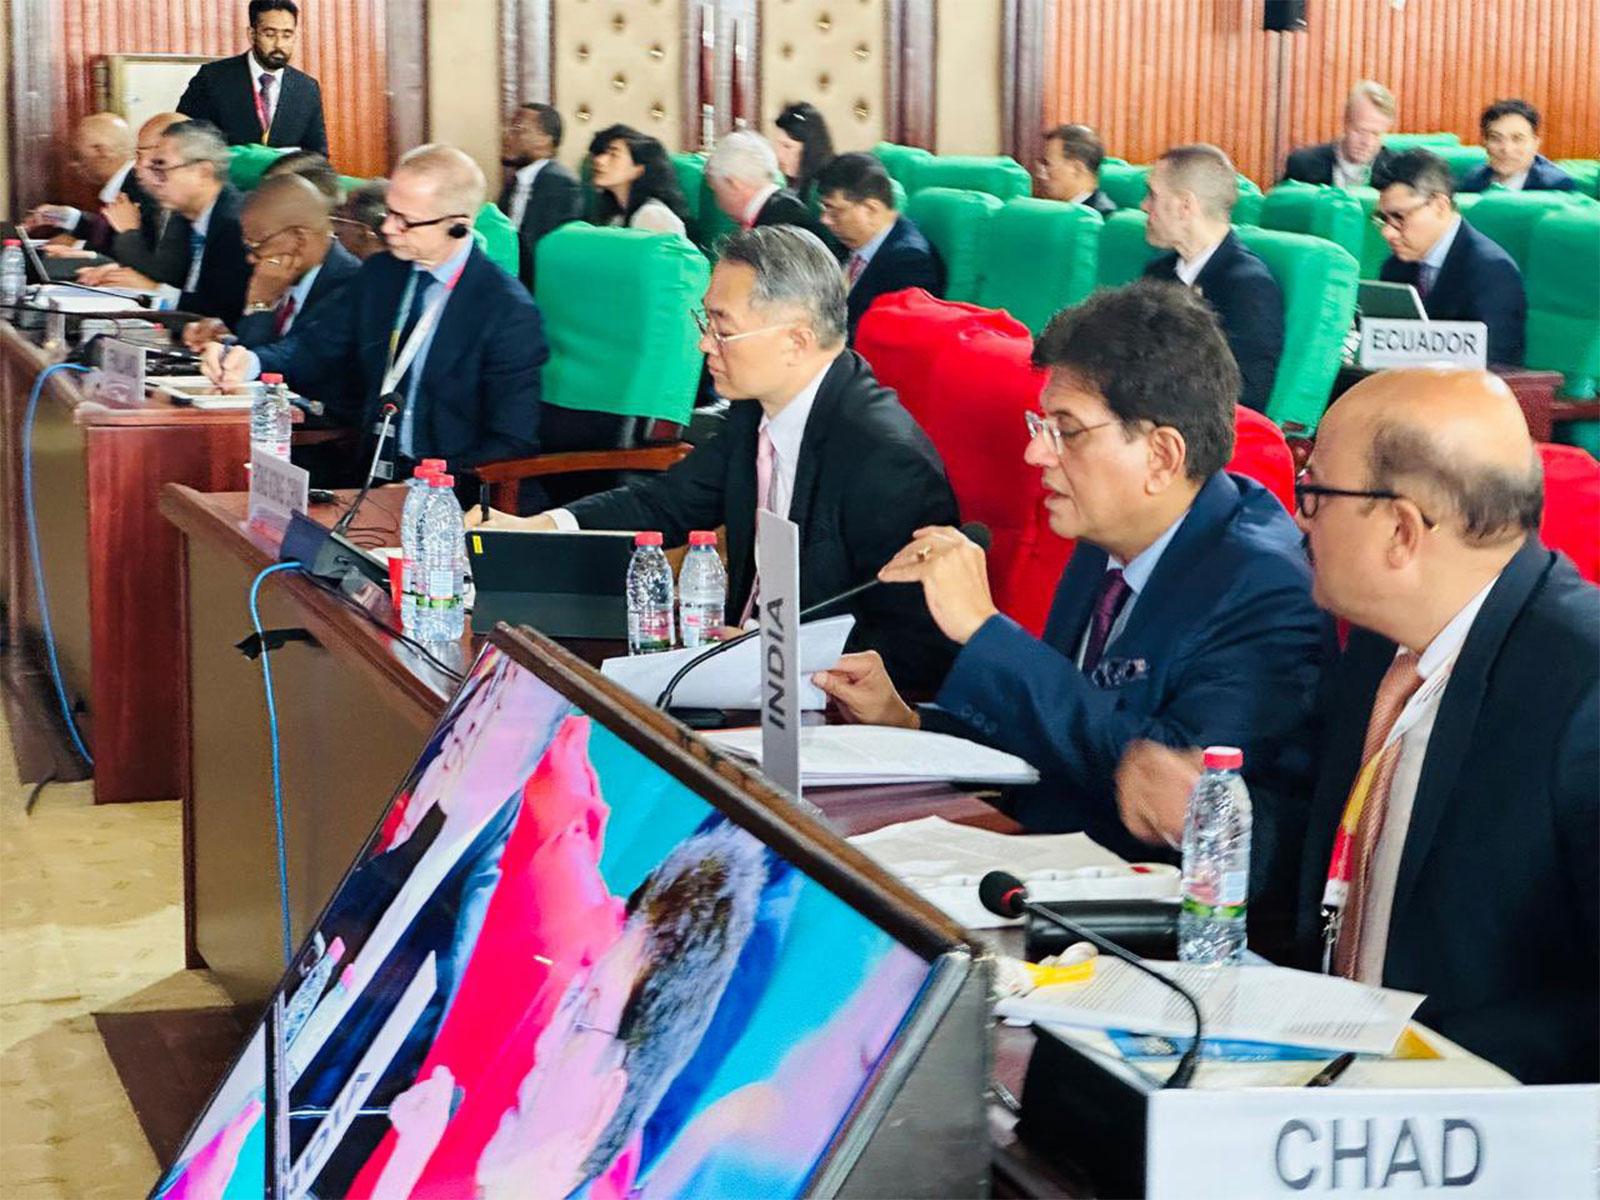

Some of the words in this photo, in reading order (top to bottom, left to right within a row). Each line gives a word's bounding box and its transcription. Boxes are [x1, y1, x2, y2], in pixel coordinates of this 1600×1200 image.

[1373, 330, 1477, 354] ECUADOR
[767, 598, 786, 730] INDIA
[1275, 1118, 1483, 1191] CHAD
